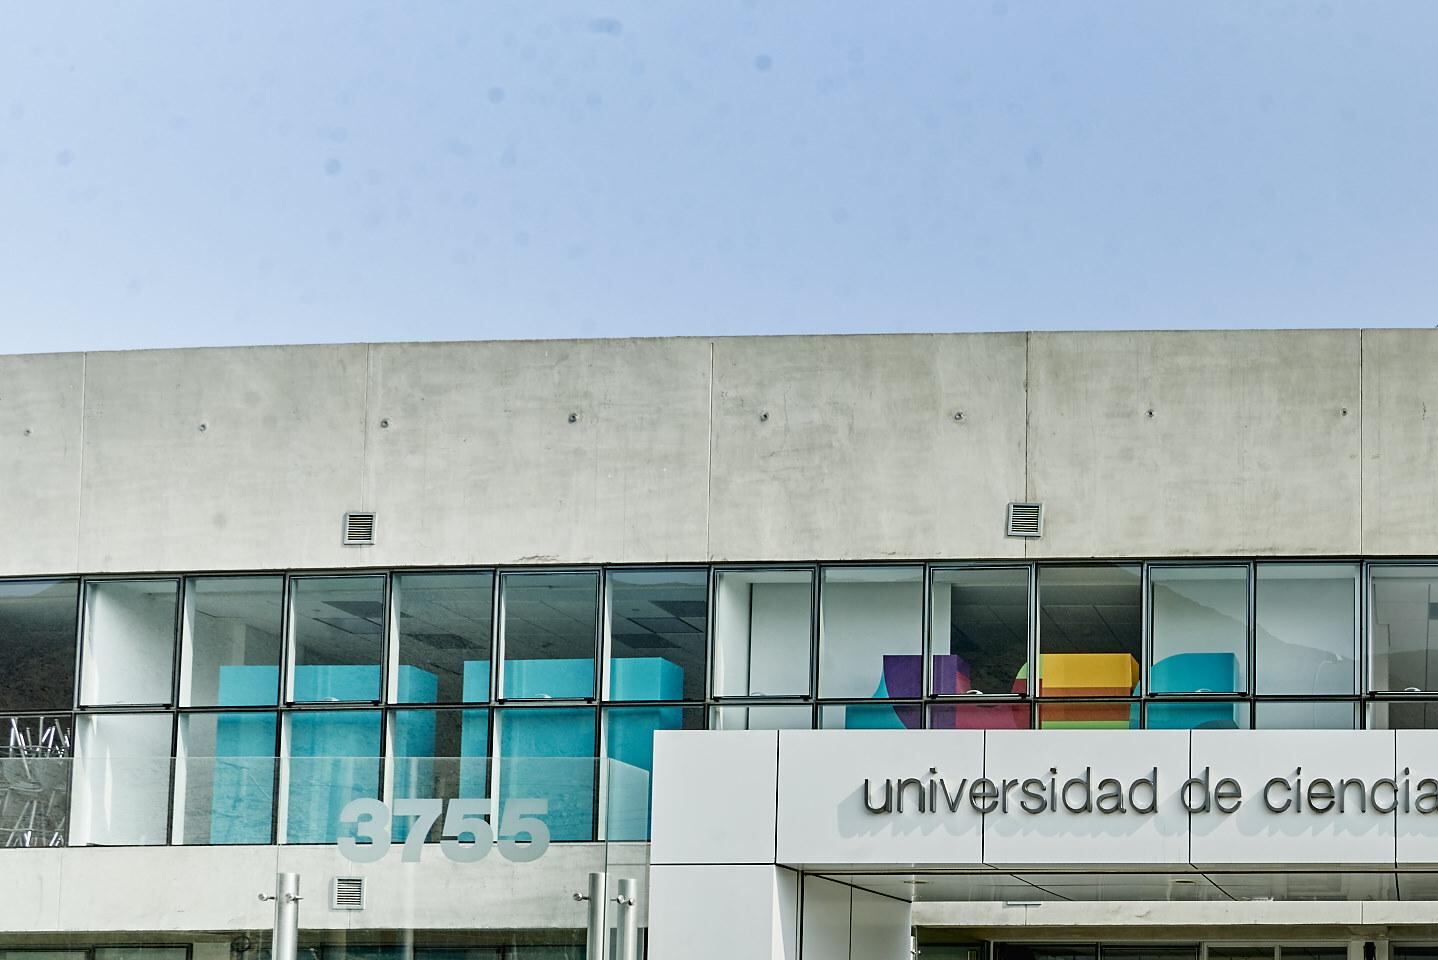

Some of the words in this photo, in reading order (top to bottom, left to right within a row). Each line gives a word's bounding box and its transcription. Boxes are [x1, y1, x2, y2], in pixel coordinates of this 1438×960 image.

[862, 767, 1159, 815] universidad
[1180, 767, 1242, 815] de
[337, 798, 550, 863] 3755
